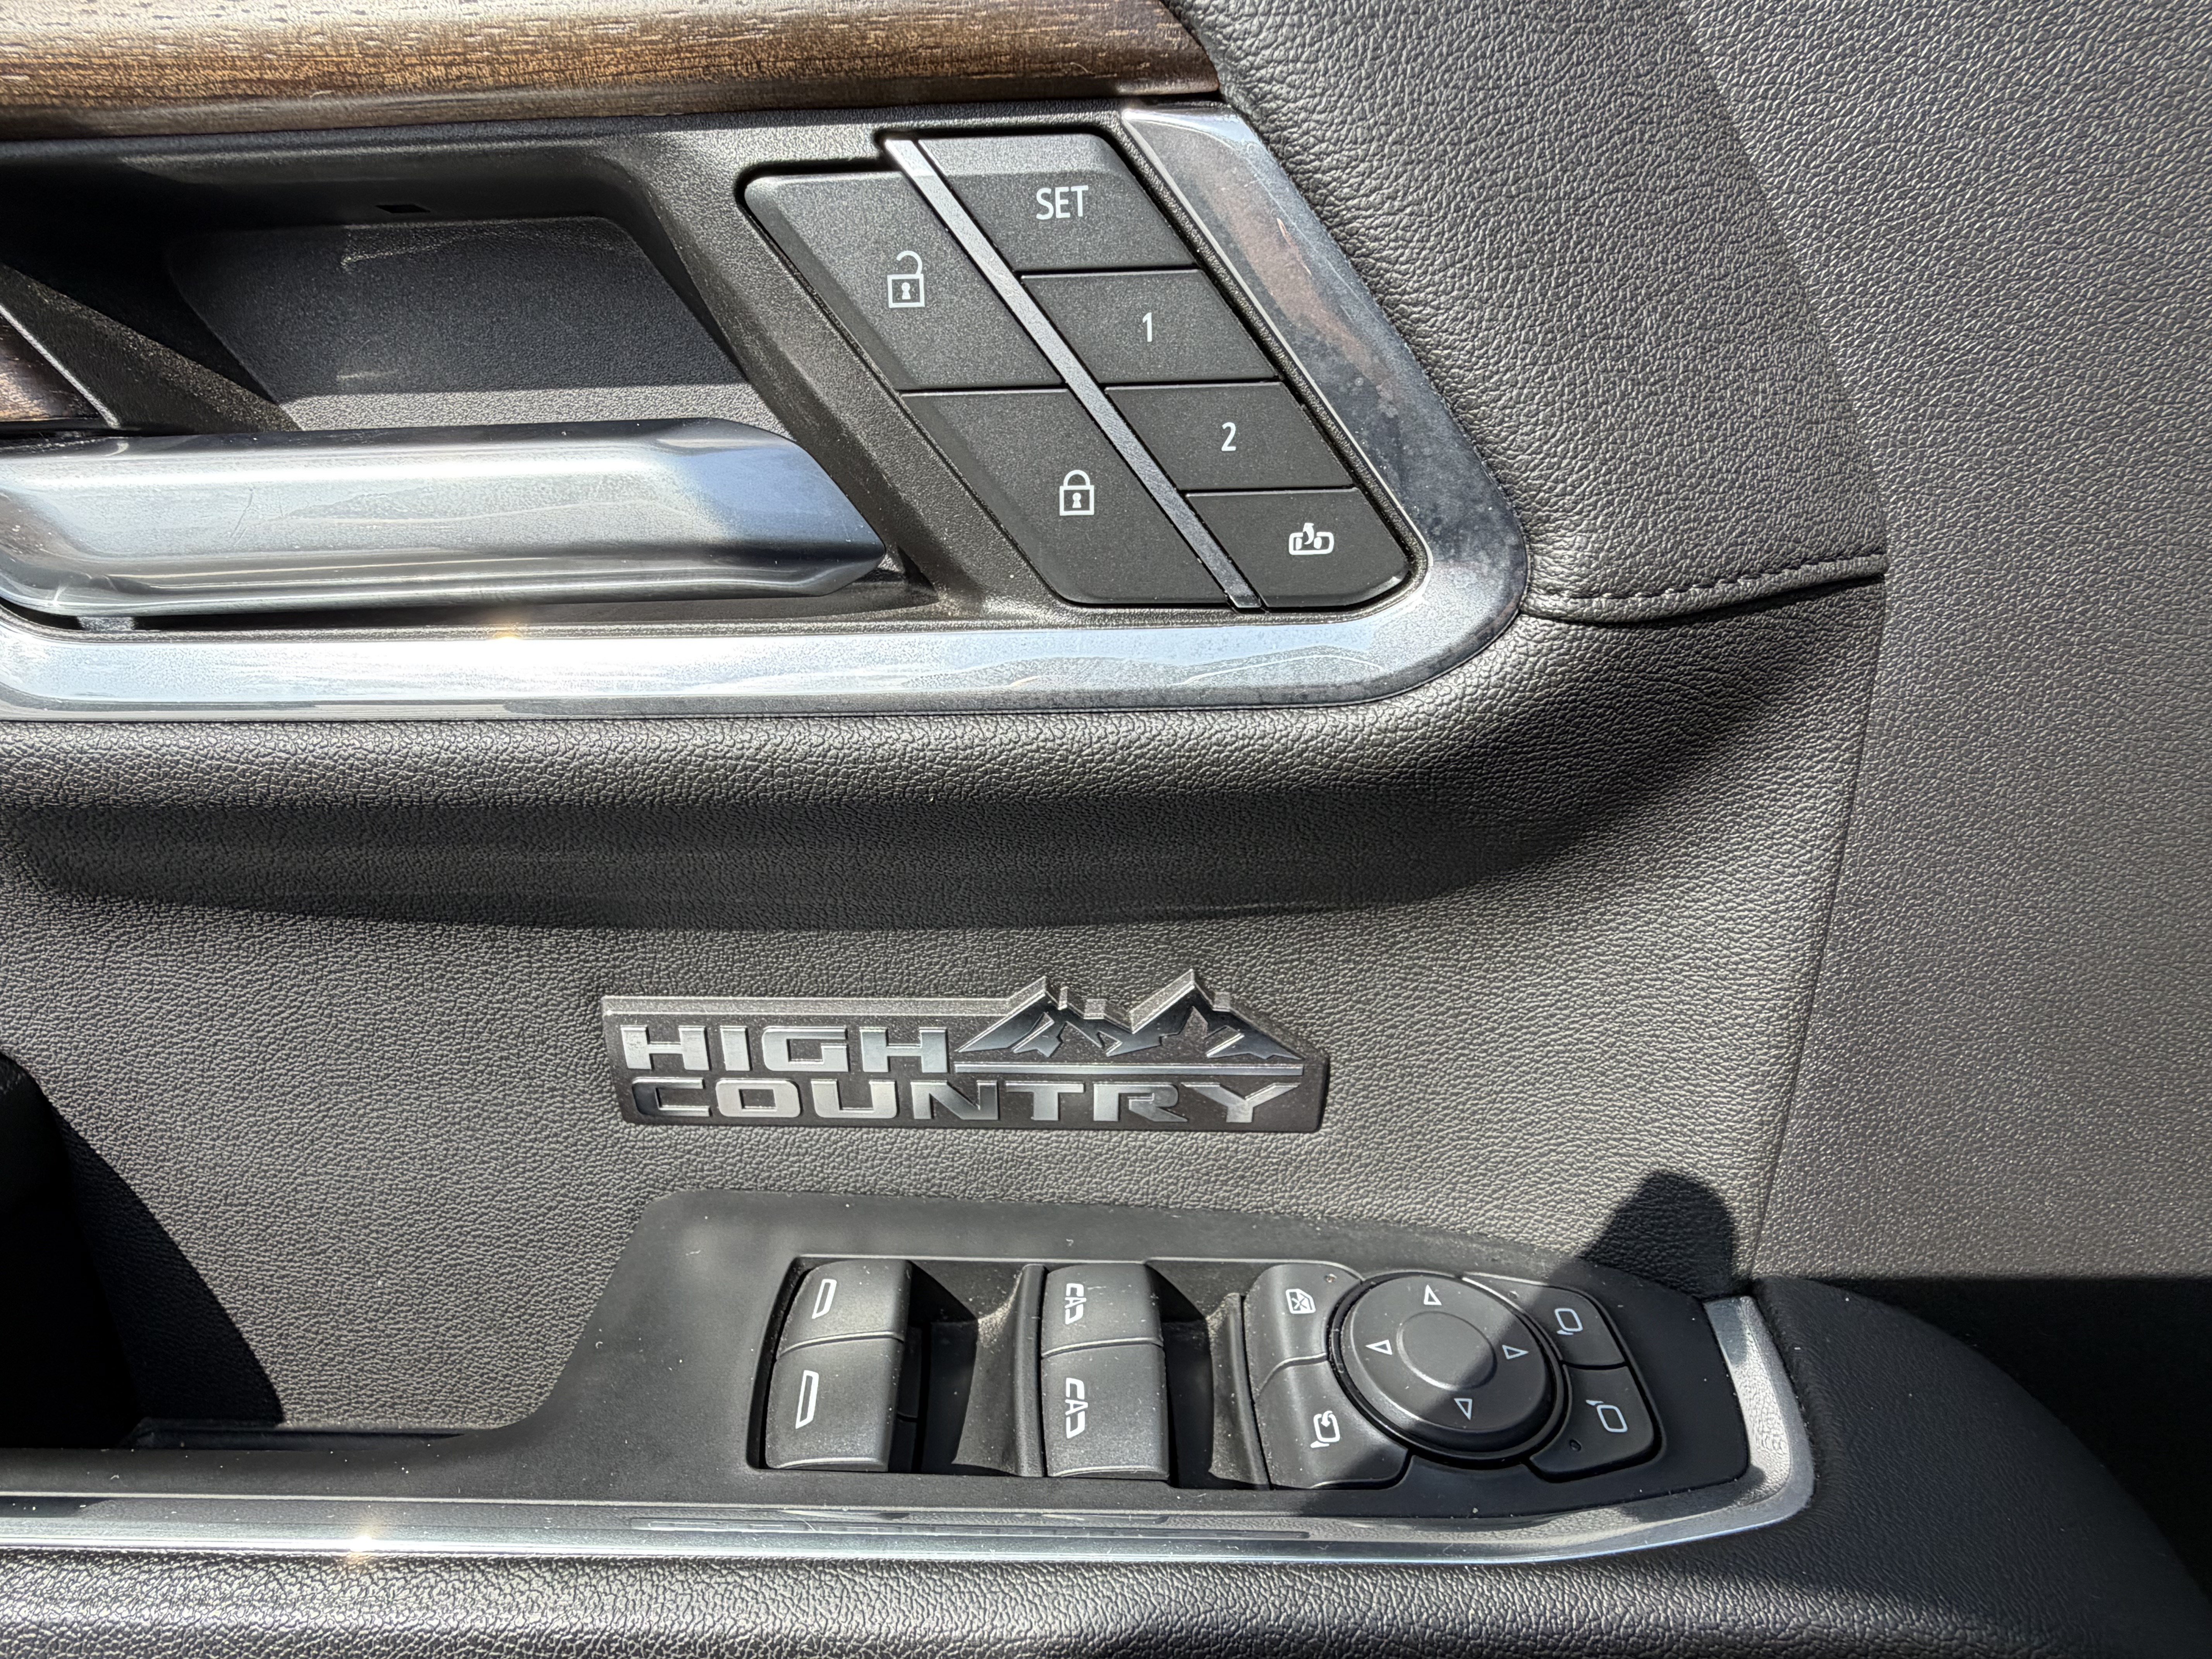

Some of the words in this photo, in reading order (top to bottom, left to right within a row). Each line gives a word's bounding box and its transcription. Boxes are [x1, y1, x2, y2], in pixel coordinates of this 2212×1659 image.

[1036, 185, 1089, 220] SET
[1142, 312, 1152, 342] 1
[1221, 422, 1236, 452] 2
[620, 1025, 949, 1073] HIGH
[631, 1077, 1300, 1123] COUNTRY
